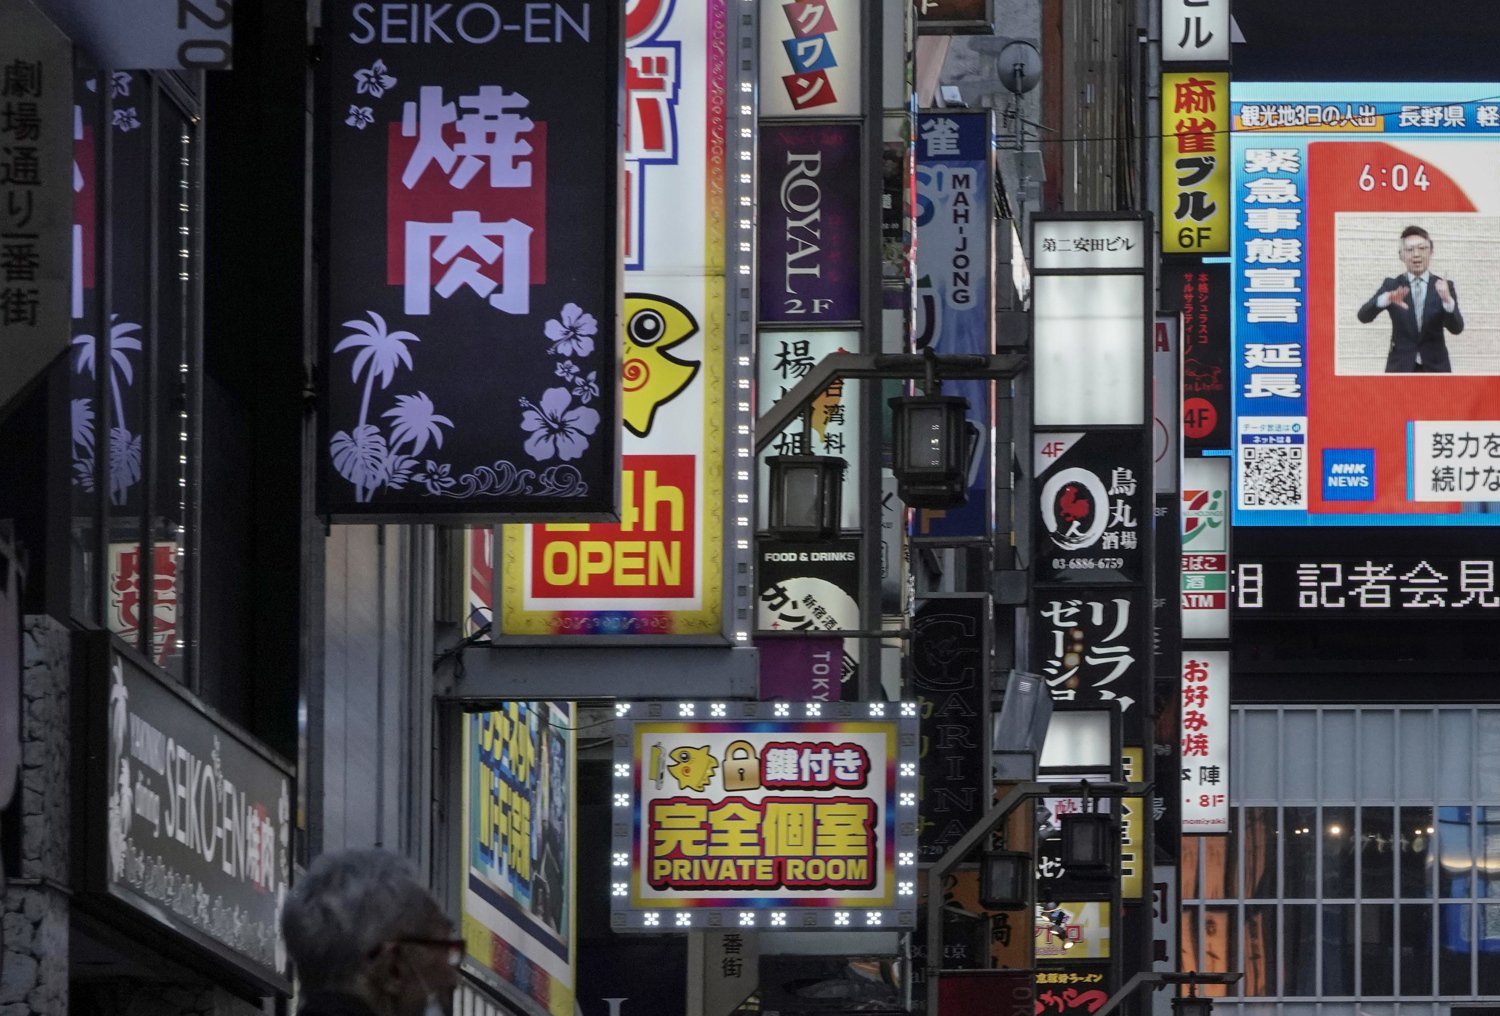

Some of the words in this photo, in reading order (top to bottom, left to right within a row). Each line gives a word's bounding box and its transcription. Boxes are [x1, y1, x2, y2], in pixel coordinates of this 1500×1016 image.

[350, 3, 591, 44] SEIKO-EN
[1240, 103, 1378, 127] 観光地3日の人出
[1398, 104, 1466, 128] 長野県
[1174, 77, 1217, 222] 麻雀ブル
[1358, 163, 1431, 192] 6:04
[1, 59, 42, 328] 劇場通り一番街
[401, 85, 534, 316] 焼肉
[780, 150, 822, 295] ROYAL
[1177, 227, 1212, 249] 6F
[1243, 147, 1303, 324] 緊急事態宣言
[1042, 238, 1137, 254] 第二安田ビル
[783, 298, 835, 315] 2F
[1243, 341, 1303, 399] 延長
[1183, 407, 1210, 429] 4F
[1041, 442, 1065, 457] 4F
[1327, 476, 1370, 488] NEWS
[1331, 463, 1367, 475] NHK
[1101, 530, 1138, 550] 酒場
[543, 541, 682, 587] OPEN
[764, 551, 798, 563] FOOD
[799, 551, 809, 563] &
[810, 551, 856, 563] DRINKS
[1185, 574, 1206, 591] 酒
[1296, 560, 1500, 608] 記者会見
[1181, 659, 1209, 758] お好み焼
[765, 748, 863, 782] 鍵付き
[654, 803, 869, 858] 完全個室
[653, 858, 774, 881] PRIVATE
[785, 858, 868, 881] ROOM
[721, 933, 743, 979] 番街
